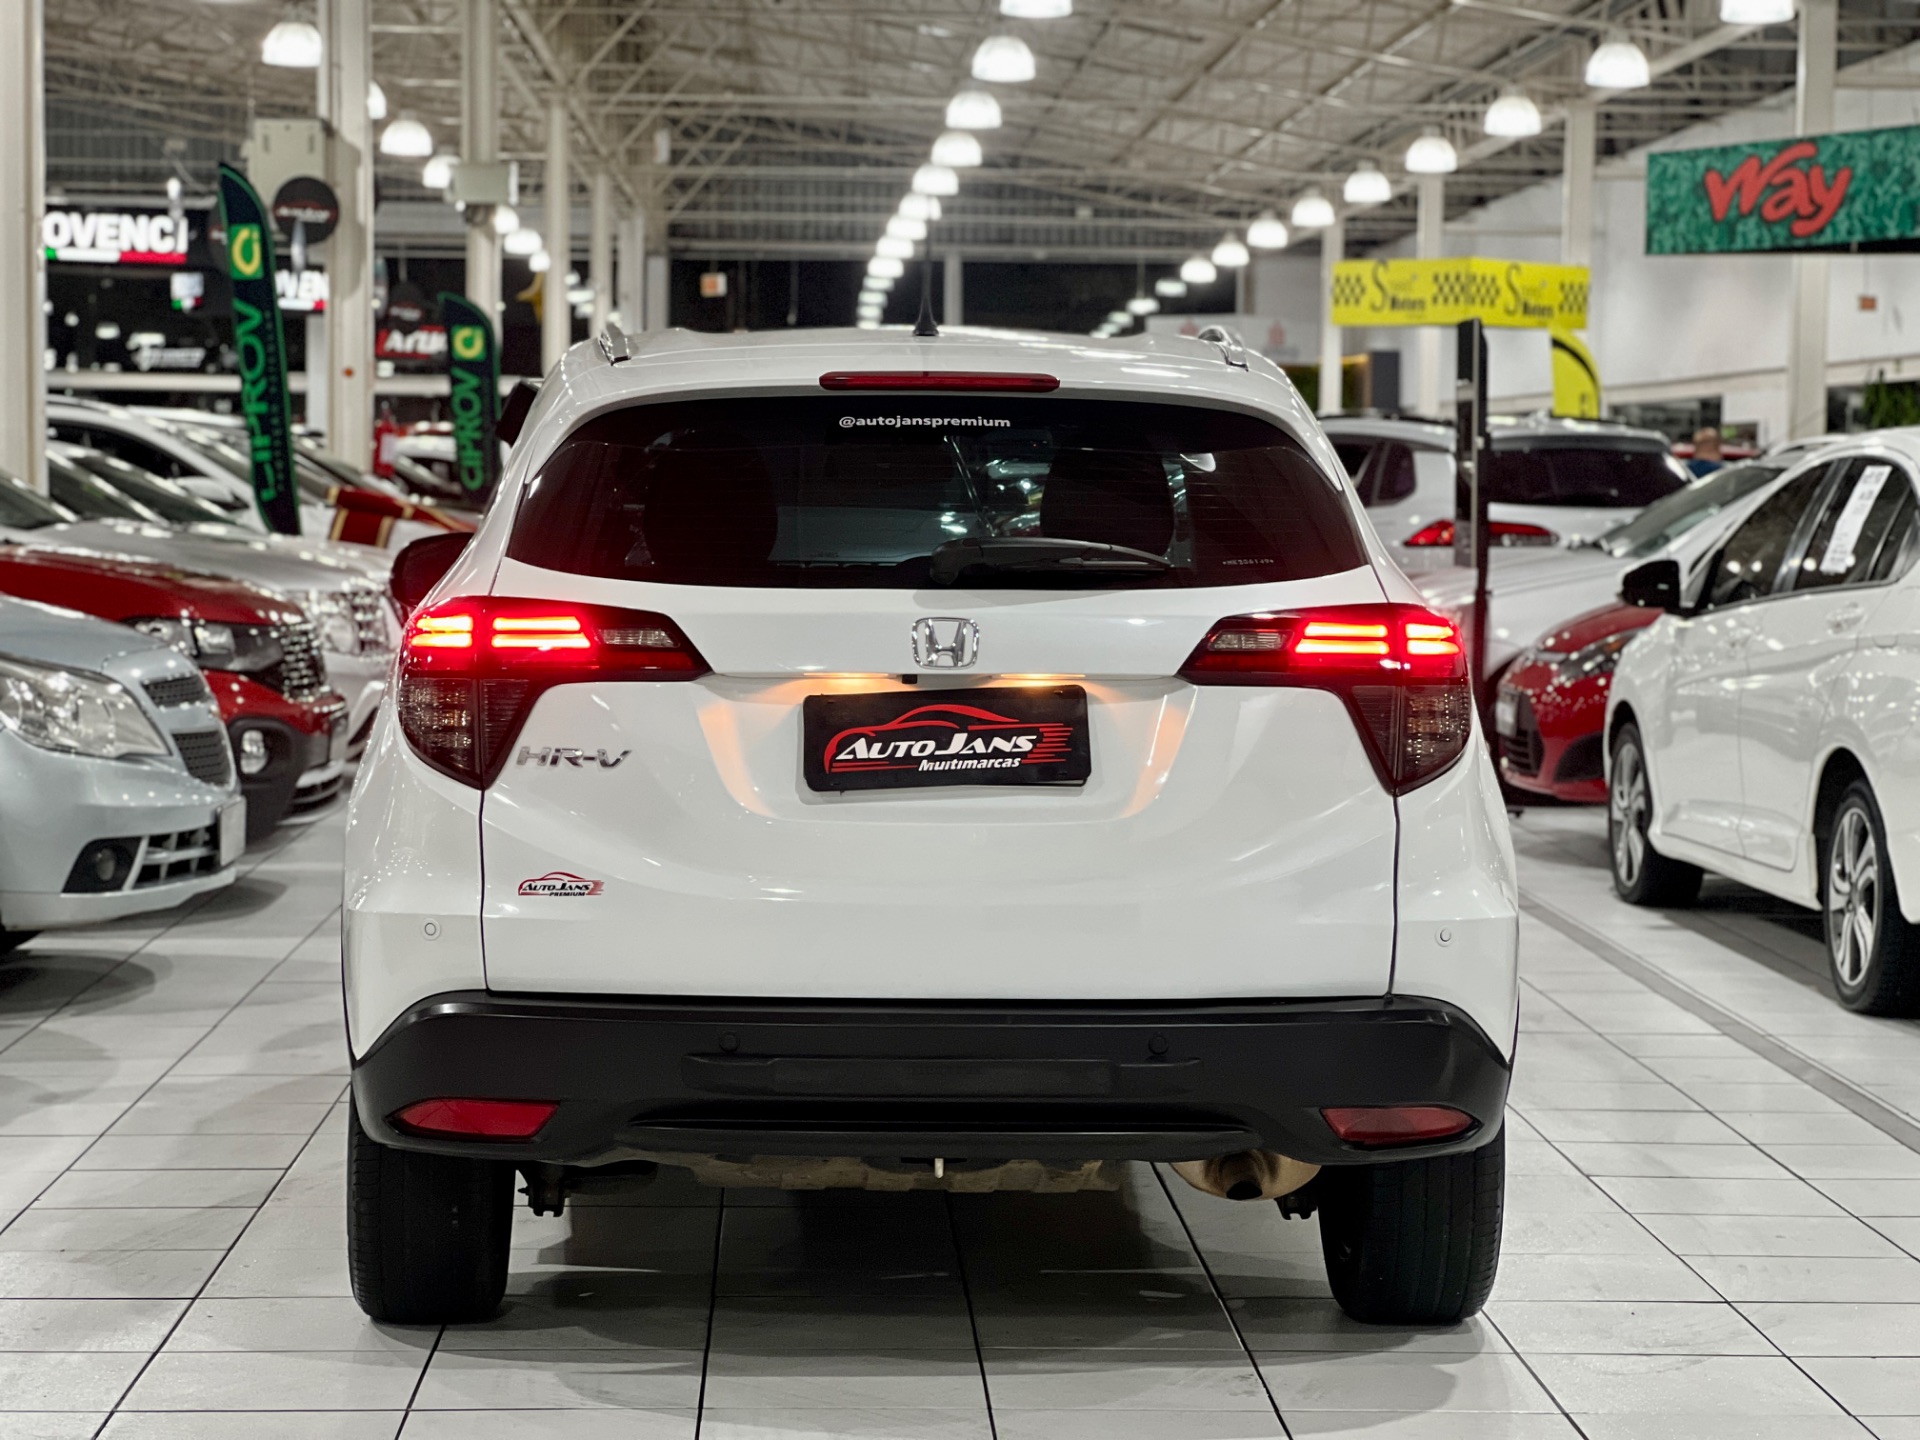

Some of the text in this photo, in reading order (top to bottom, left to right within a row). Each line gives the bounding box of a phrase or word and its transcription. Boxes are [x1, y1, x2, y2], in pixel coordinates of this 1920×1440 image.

[1704, 141, 1853, 237] Way
[838, 416, 1011, 428] @autojanspremium
[516, 746, 632, 767] HR-V
[918, 757, 1021, 772] Multimarcas
